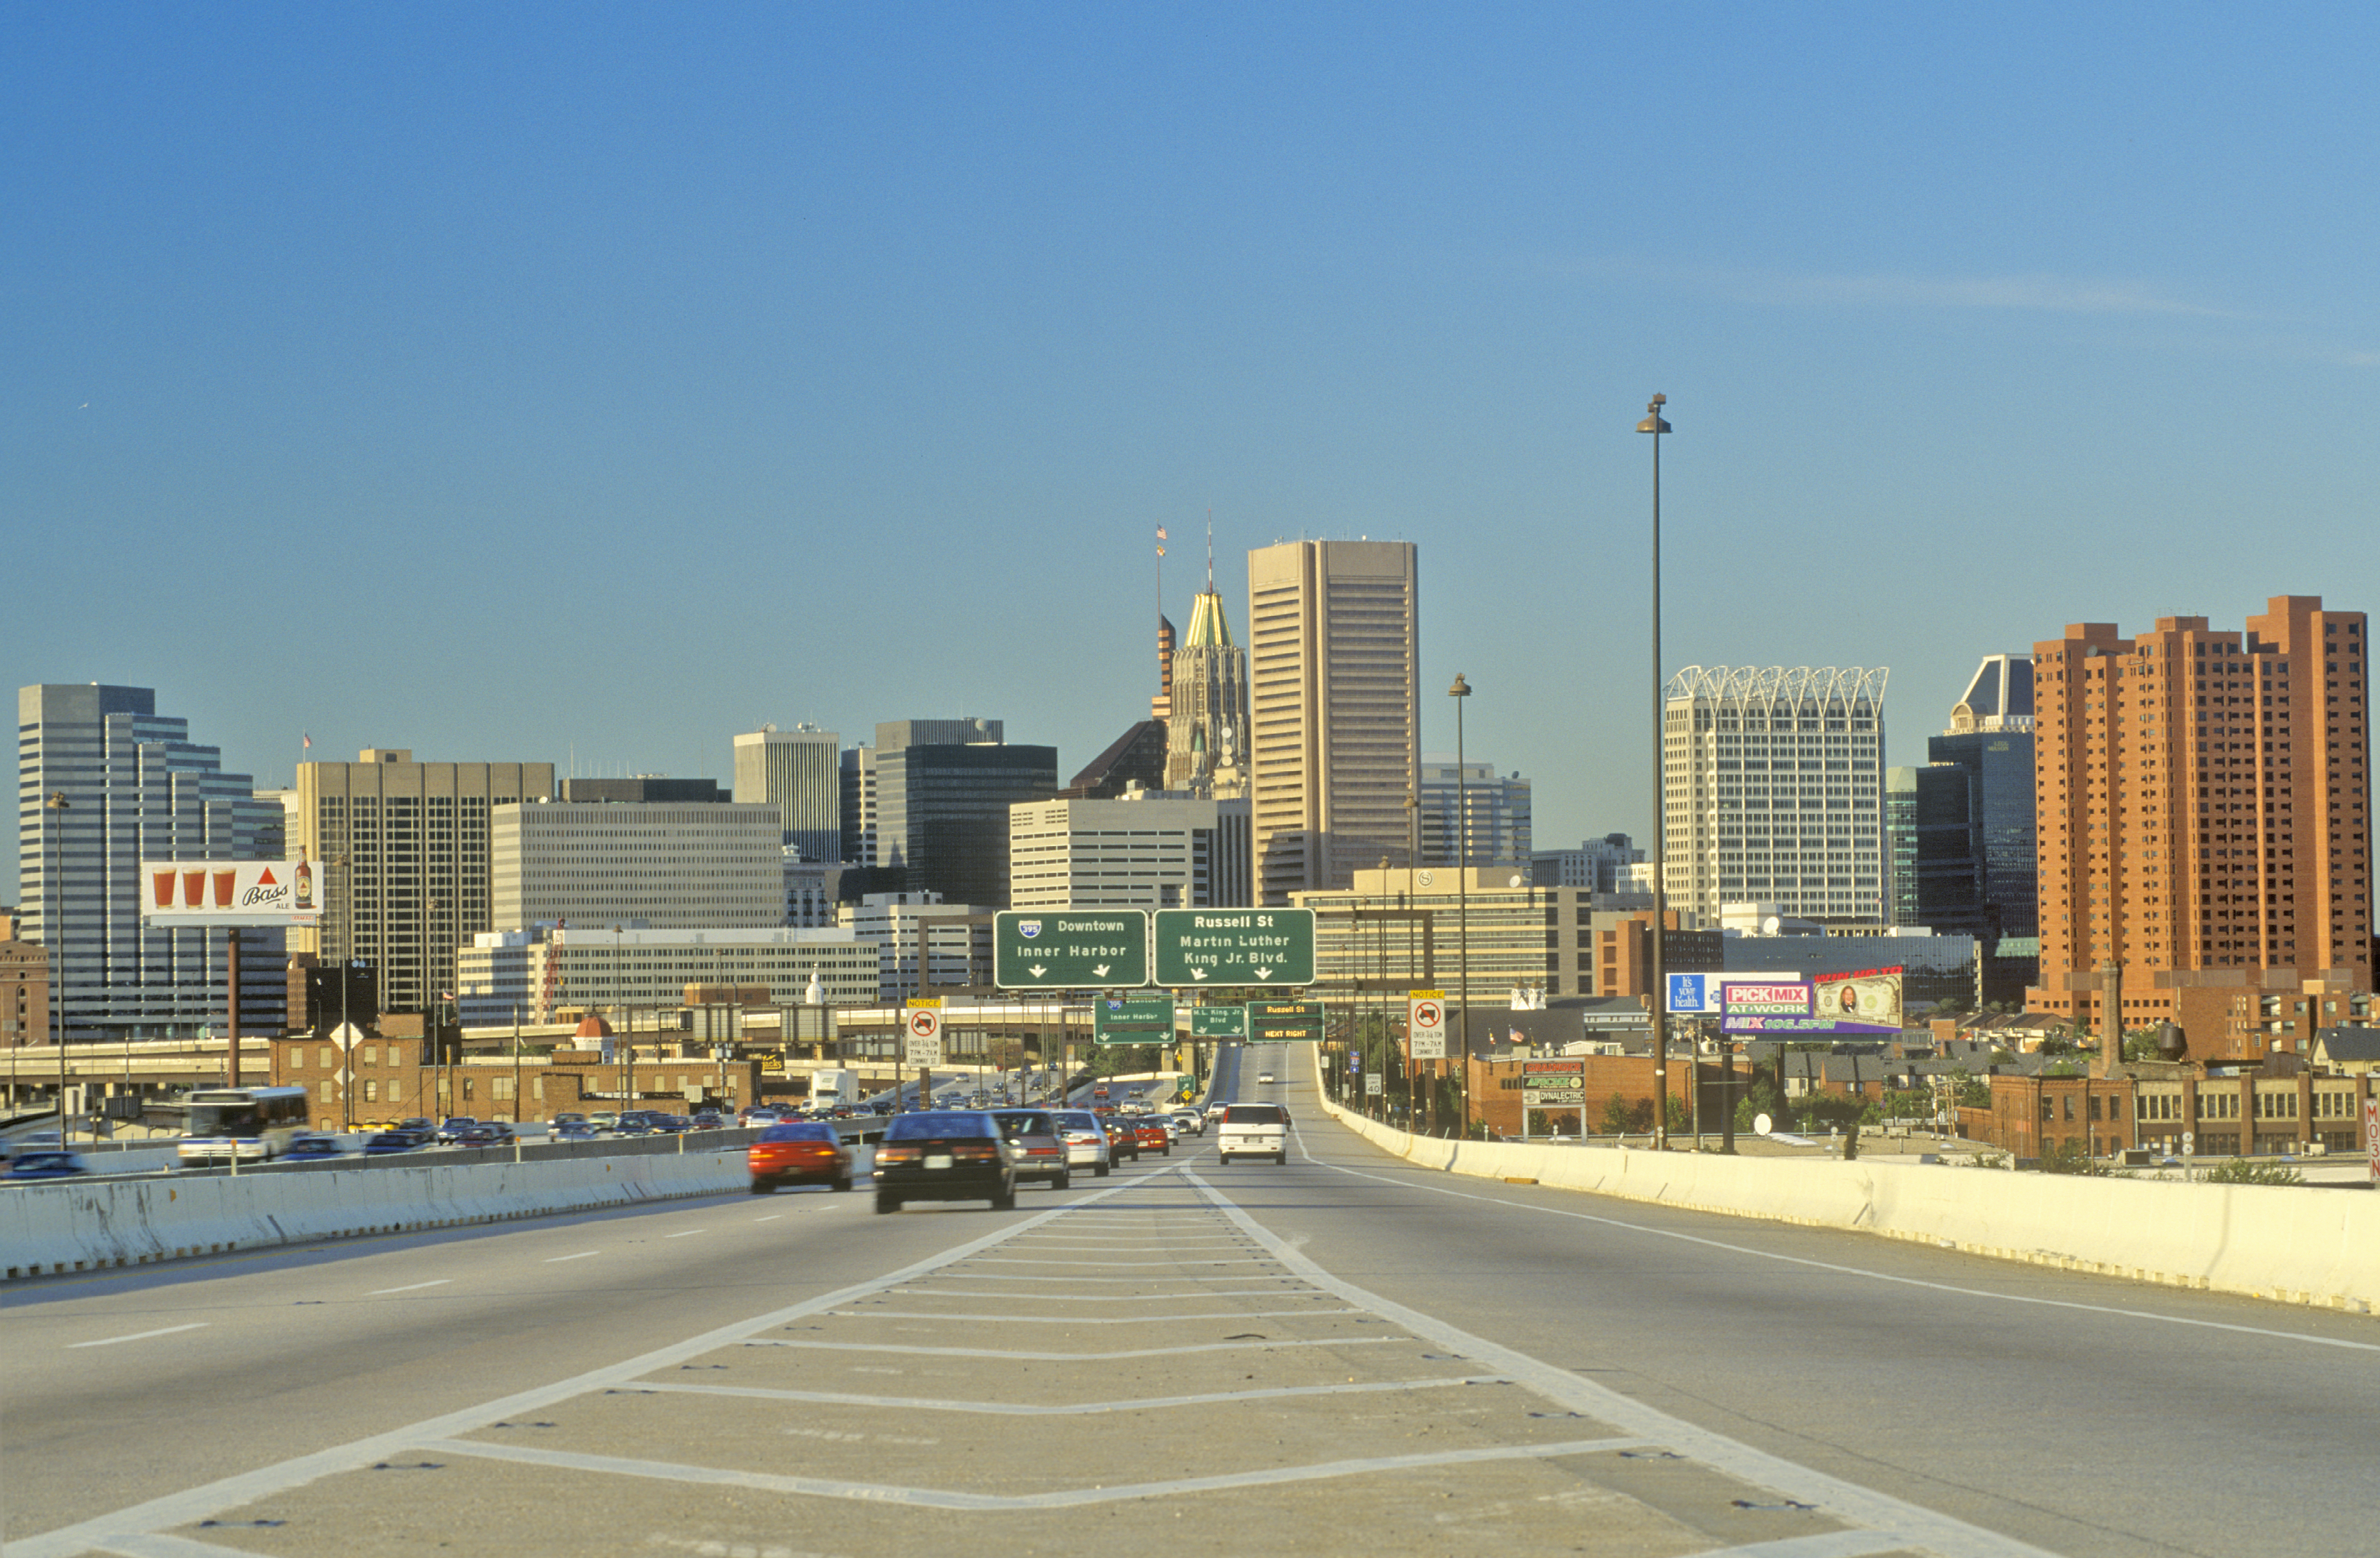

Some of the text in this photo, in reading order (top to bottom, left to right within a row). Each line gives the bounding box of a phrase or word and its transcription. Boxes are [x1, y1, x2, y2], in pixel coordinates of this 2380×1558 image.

[242, 885, 288, 906] Bass
[1058, 920, 1124, 931] Downtown
[1194, 915, 1273, 928] Russell St
[1180, 935, 1290, 947] Martin Luther
[1017, 945, 1126, 957] Inner Harbor
[1184, 952, 1287, 967] King Jr. Blvd.
[1814, 966, 1903, 983] WIN UP TO
[1682, 976, 1693, 987] It's
[1731, 988, 1804, 1001] PICK MIX
[1675, 995, 1699, 1007] health.
[1725, 1017, 1836, 1030] MIX 106.5FM
[1526, 1063, 1581, 1072] GRAINGER
[1526, 1077, 1570, 1086] AFSCME
[1540, 1092, 1584, 1100] DYNALECTRIC
